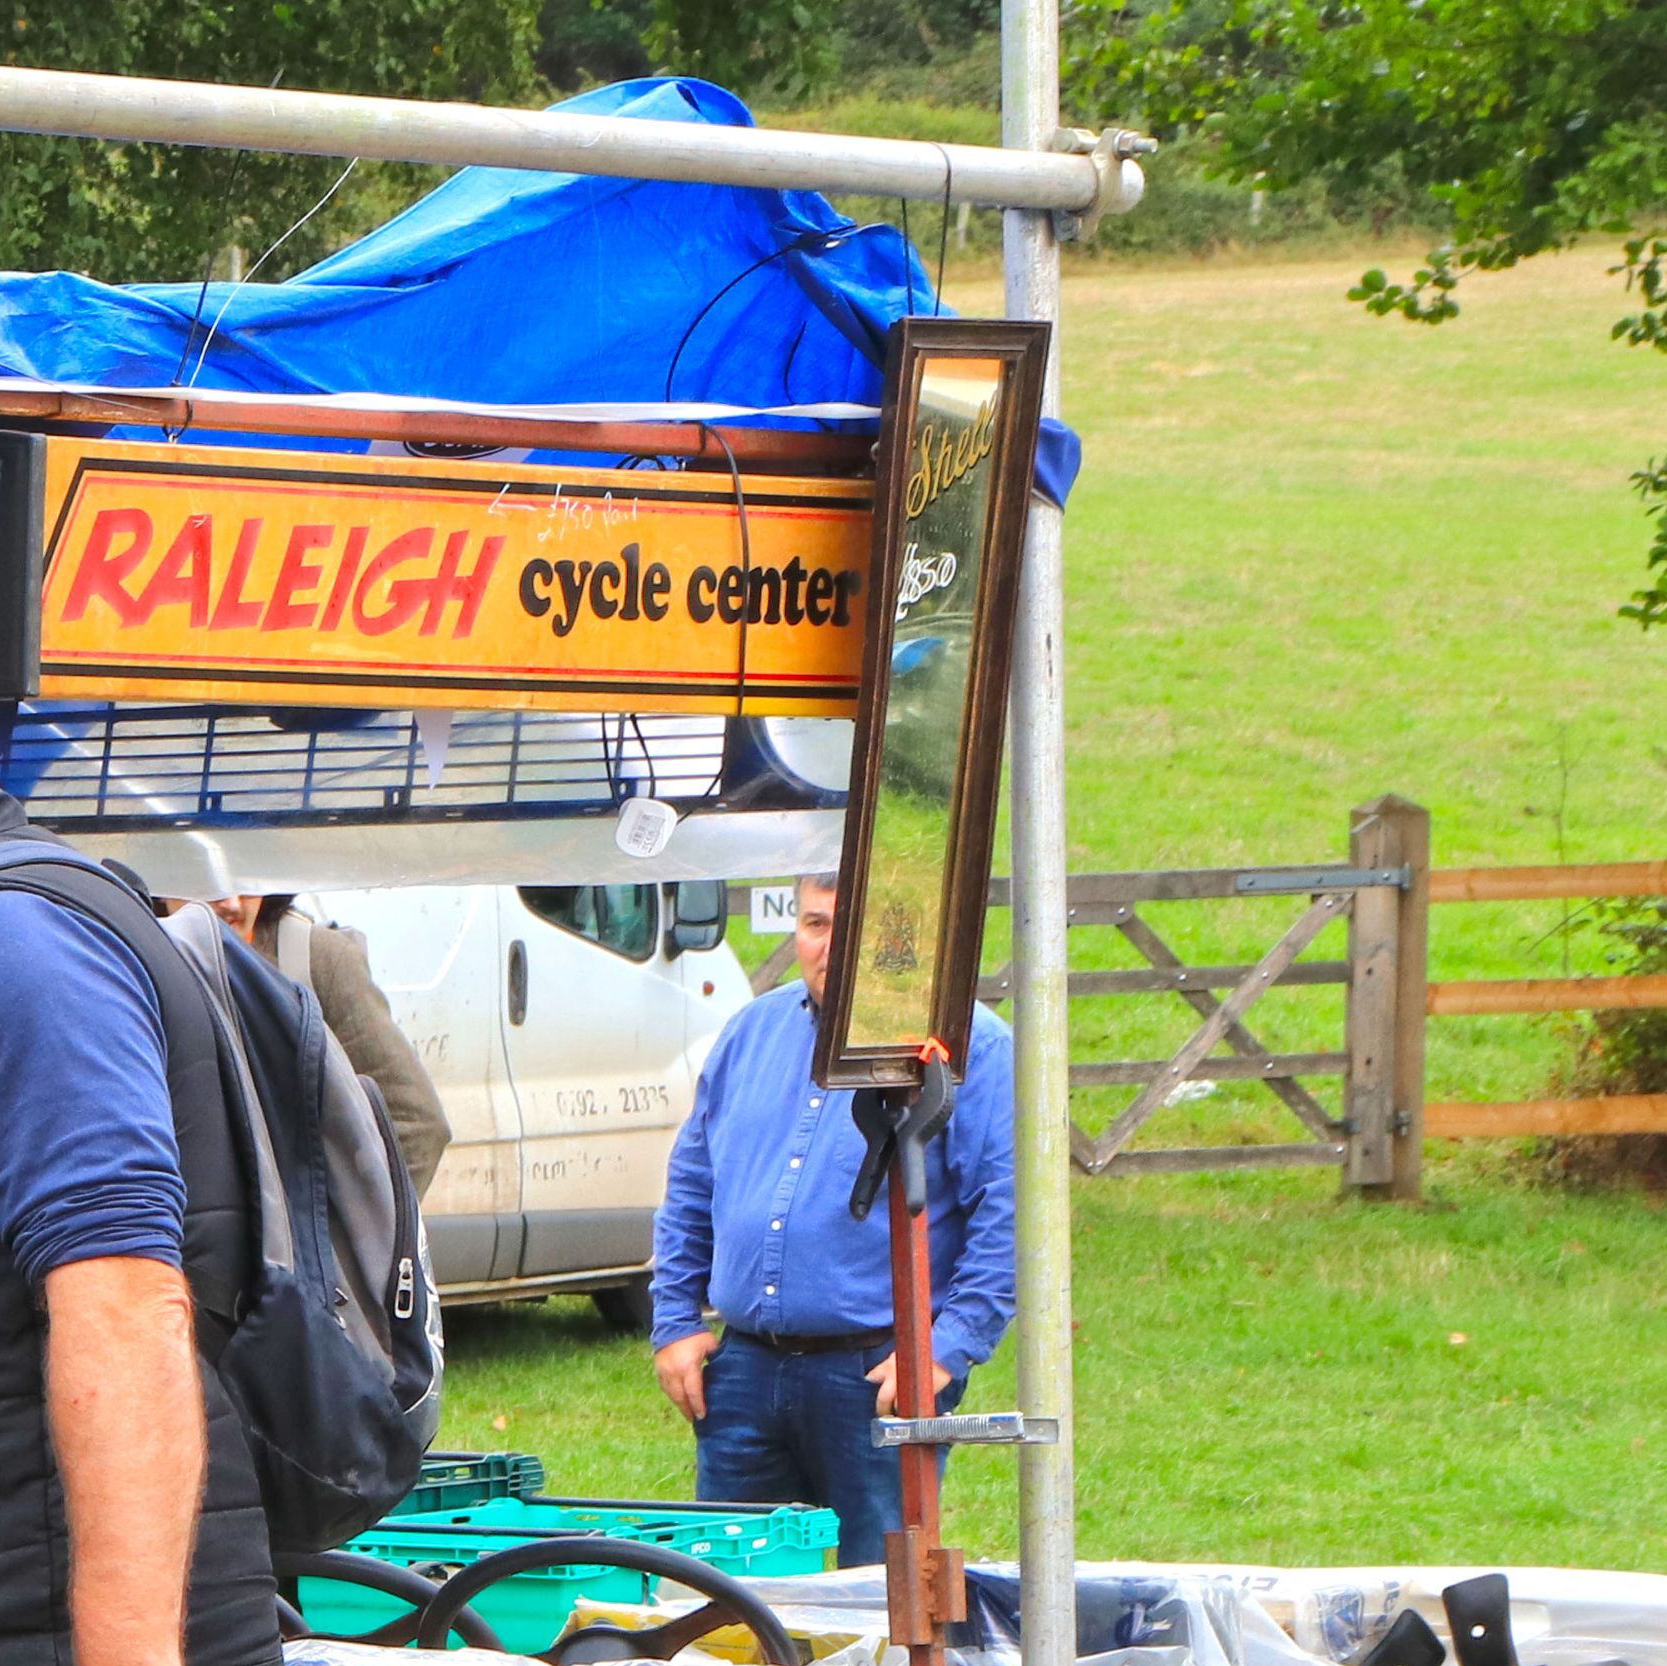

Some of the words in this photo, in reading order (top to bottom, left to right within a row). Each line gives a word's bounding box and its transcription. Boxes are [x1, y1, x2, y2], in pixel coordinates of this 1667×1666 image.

[906, 390, 1000, 520] Shell
[62, 506, 506, 640] RALEIGH
[518, 540, 670, 638] cycle
[686, 554, 861, 628] center
